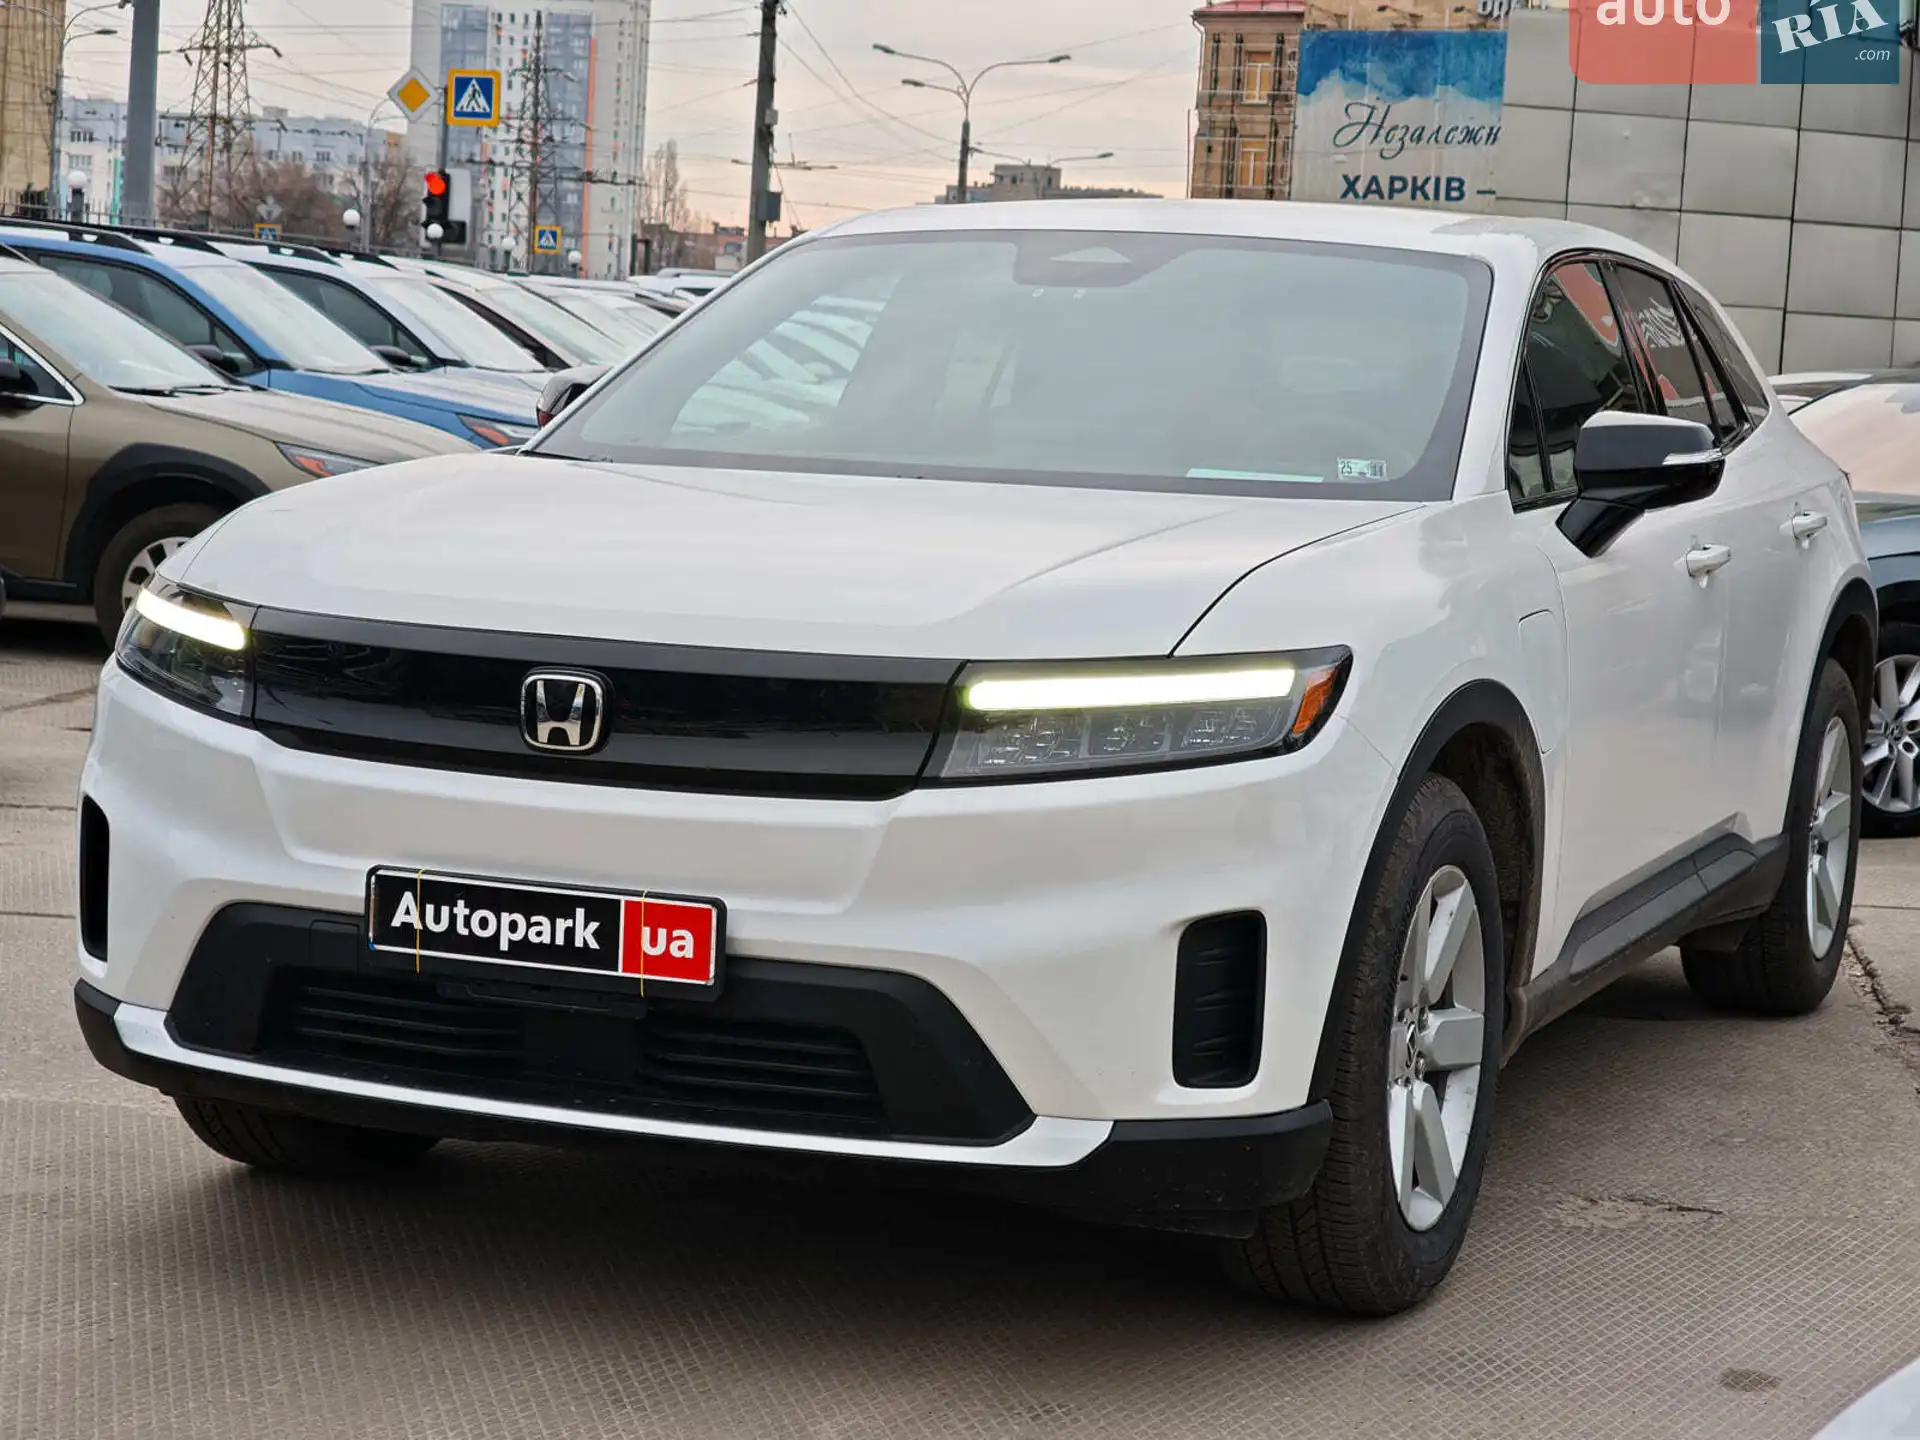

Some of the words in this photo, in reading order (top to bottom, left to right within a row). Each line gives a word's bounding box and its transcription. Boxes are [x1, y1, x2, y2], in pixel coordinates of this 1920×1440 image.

[1340, 174, 1466, 202] ХАРКІВ
[391, 891, 601, 951] Autopark
[641, 925, 694, 959] ua
